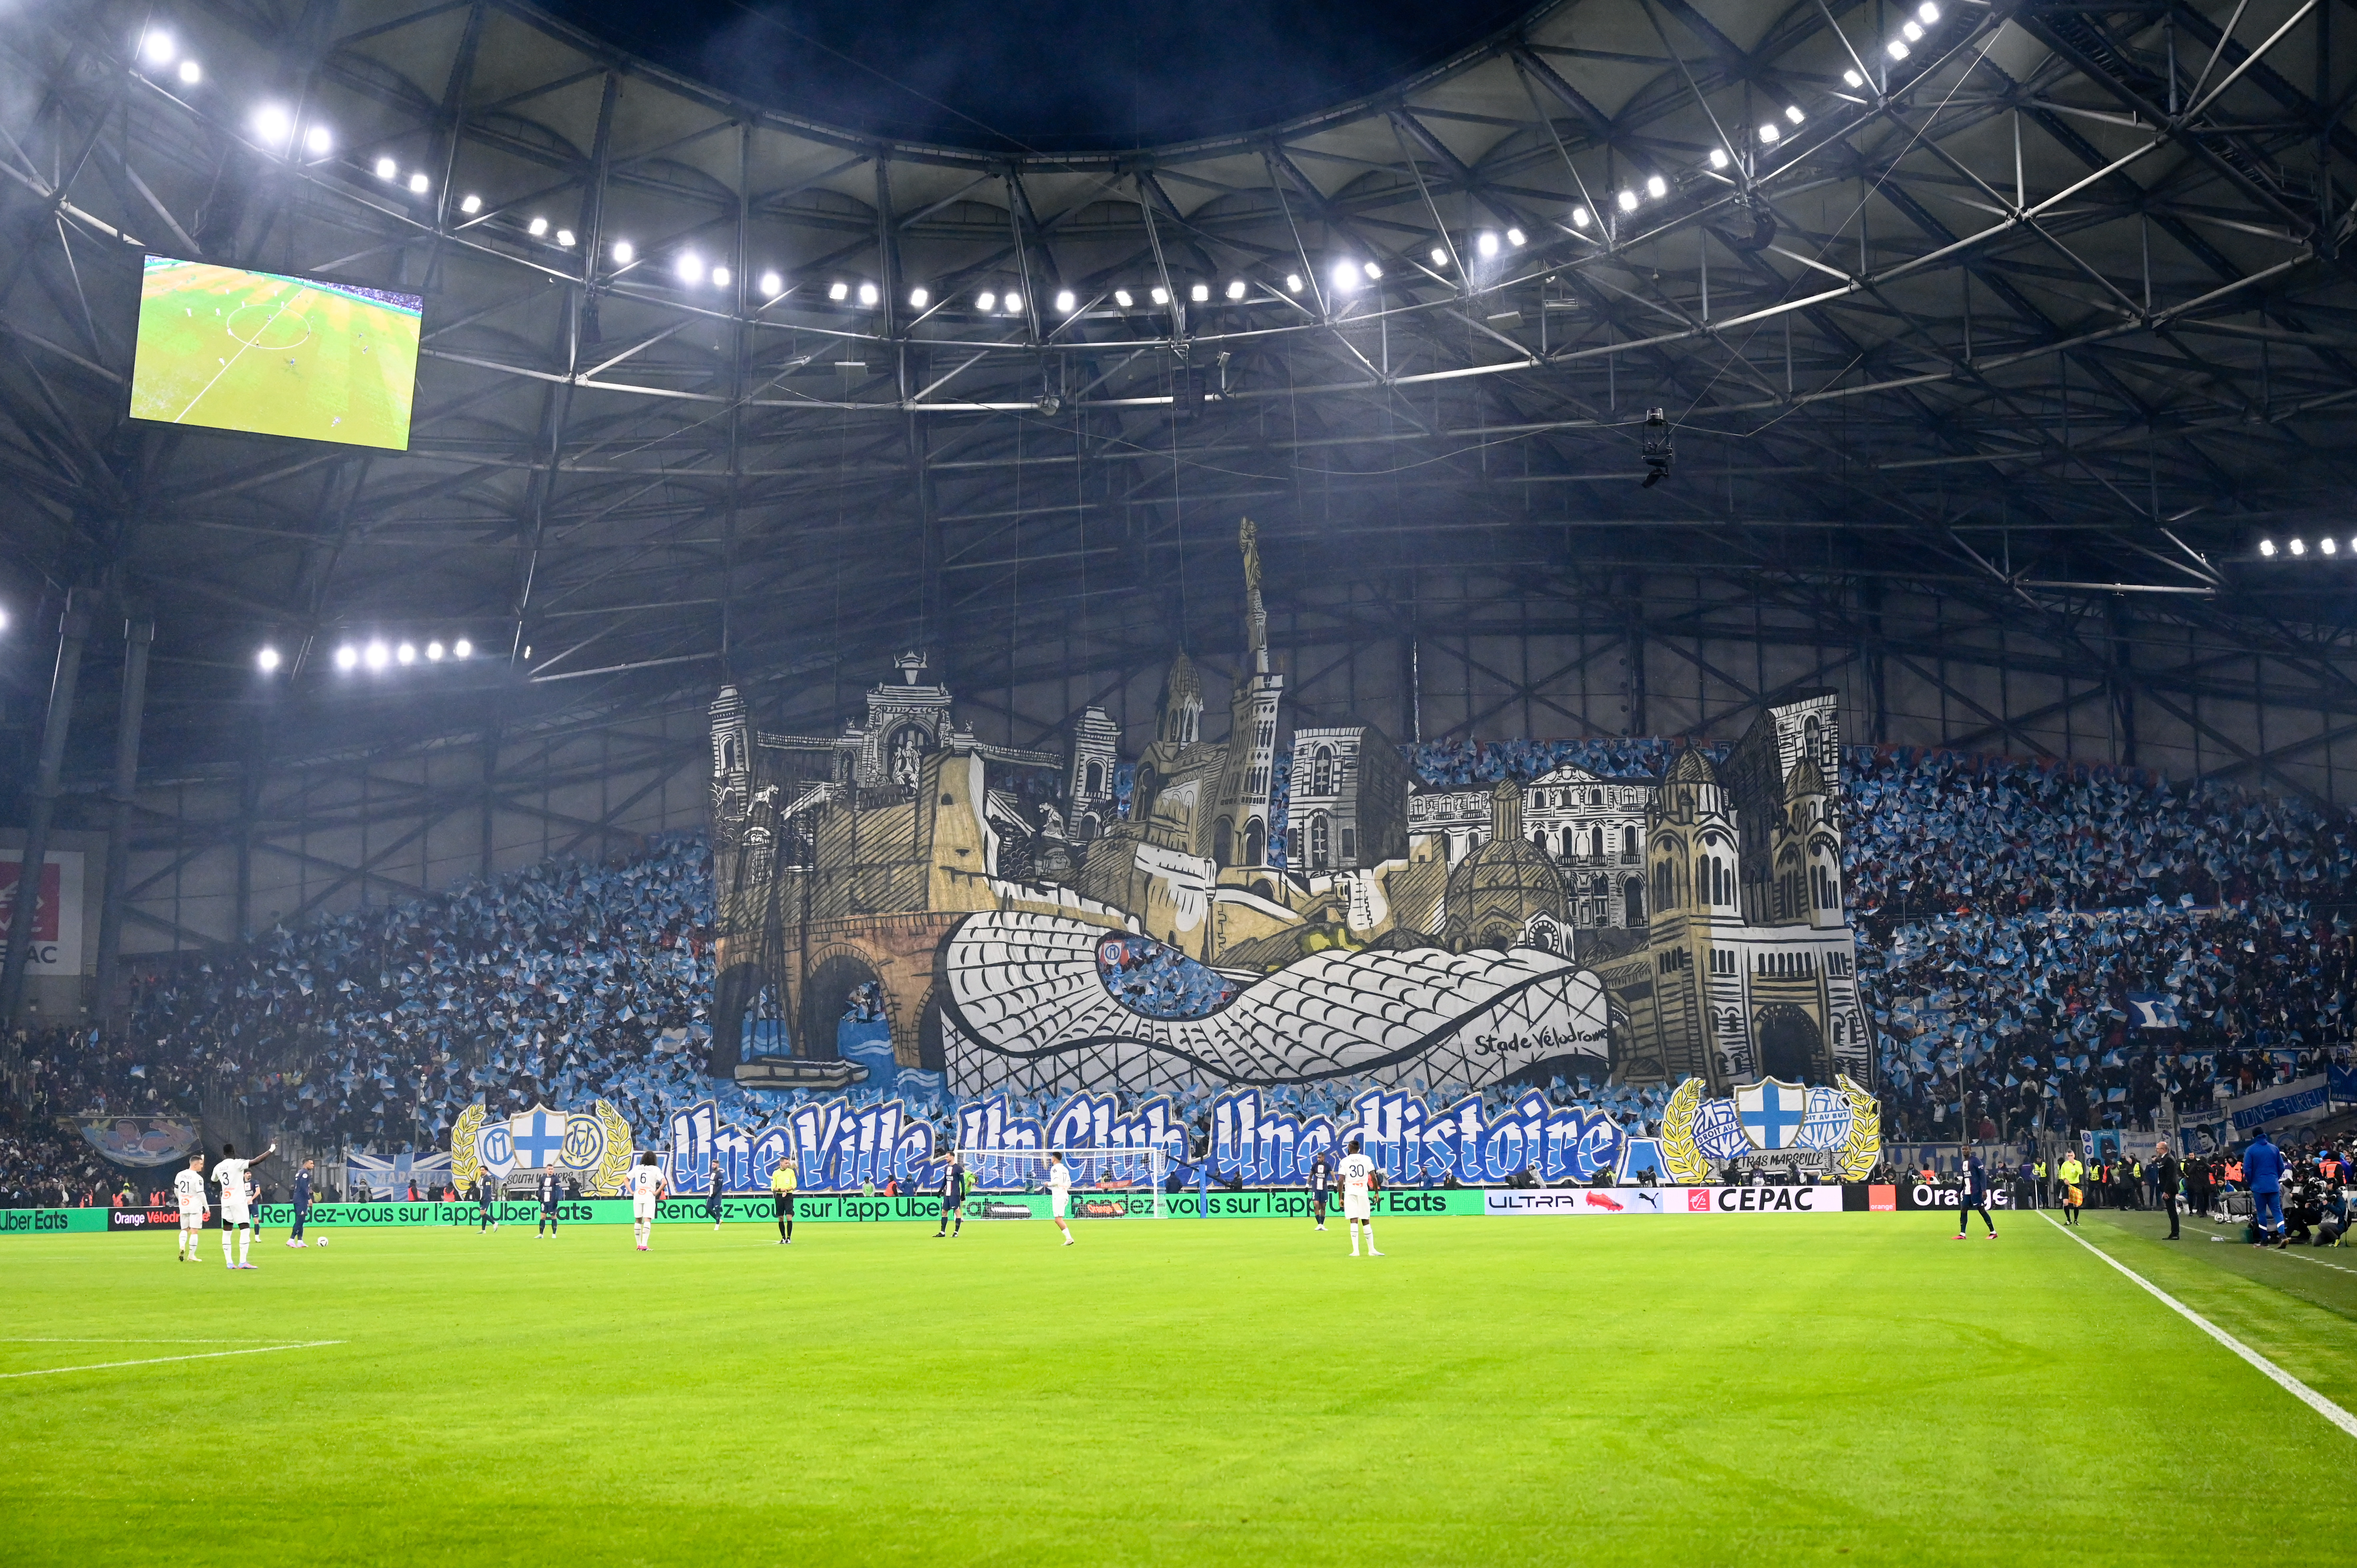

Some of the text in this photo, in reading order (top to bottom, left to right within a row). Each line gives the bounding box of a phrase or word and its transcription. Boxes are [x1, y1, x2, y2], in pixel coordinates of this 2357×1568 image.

[1475, 1022, 1608, 1056] Stade Vélodrome
[1697, 1127, 1721, 1144] DROIT
[1723, 1123, 1733, 1133] AU
[672, 1090, 1620, 1192] Une Ville Un Club Une Histoire
[1770, 1152, 1823, 1166] MARSEILLE
[640, 1173, 647, 1183] 6
[1063, 1172, 1067, 1183] 17
[1349, 1164, 1364, 1178] 30
[222, 1172, 229, 1186] 3
[507, 1174, 534, 1185] SOUTH
[180, 1180, 189, 1193] 21
[1226, 1198, 1260, 1213] sur
[1390, 1192, 1446, 1212] Eats
[1489, 1196, 1574, 1208] ULTRA
[1718, 1188, 1813, 1212] CEPAC
[399, 1207, 429, 1222] sur
[490, 1203, 538, 1221] Uber
[545, 1204, 593, 1220] ats
[800, 1202, 832, 1218] sur
[838, 1198, 890, 1221] l'app
[895, 1198, 943, 1217] Ube
[1087, 1204, 1113, 1214] Orange
[35, 1210, 68, 1229] Eats
[114, 1211, 210, 1226] Orange Vélodre
